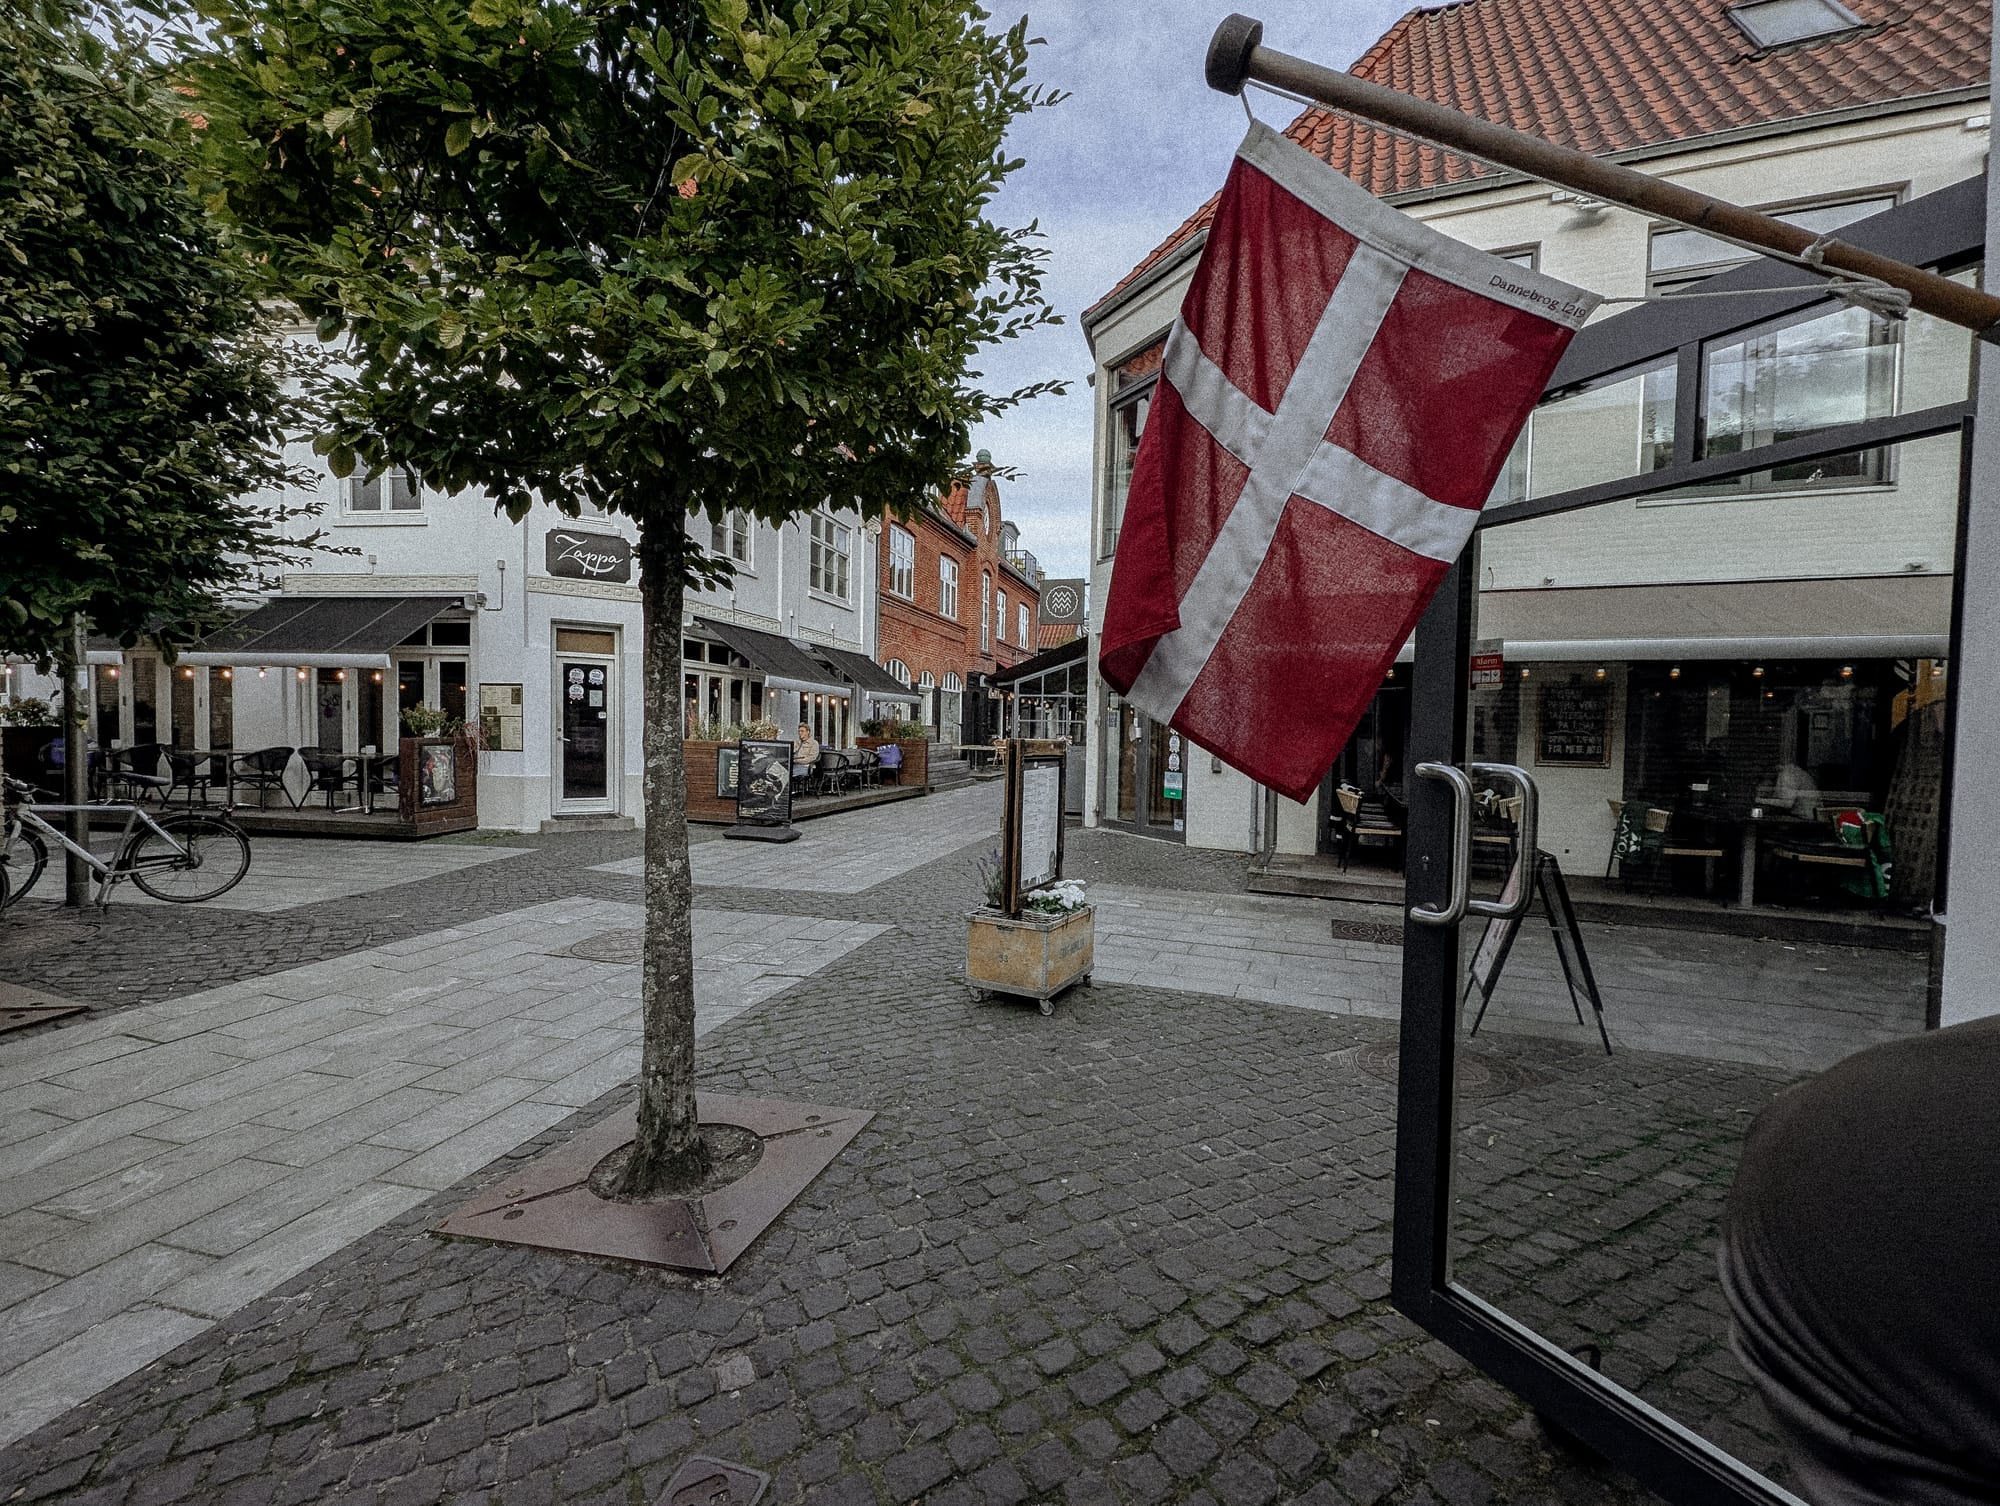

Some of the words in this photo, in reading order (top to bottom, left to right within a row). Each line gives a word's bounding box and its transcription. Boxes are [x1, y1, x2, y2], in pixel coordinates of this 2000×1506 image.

[1489, 274, 1560, 311] Dannebrog
[1562, 302, 1587, 319] 1219
[555, 534, 624, 577] Zappa
